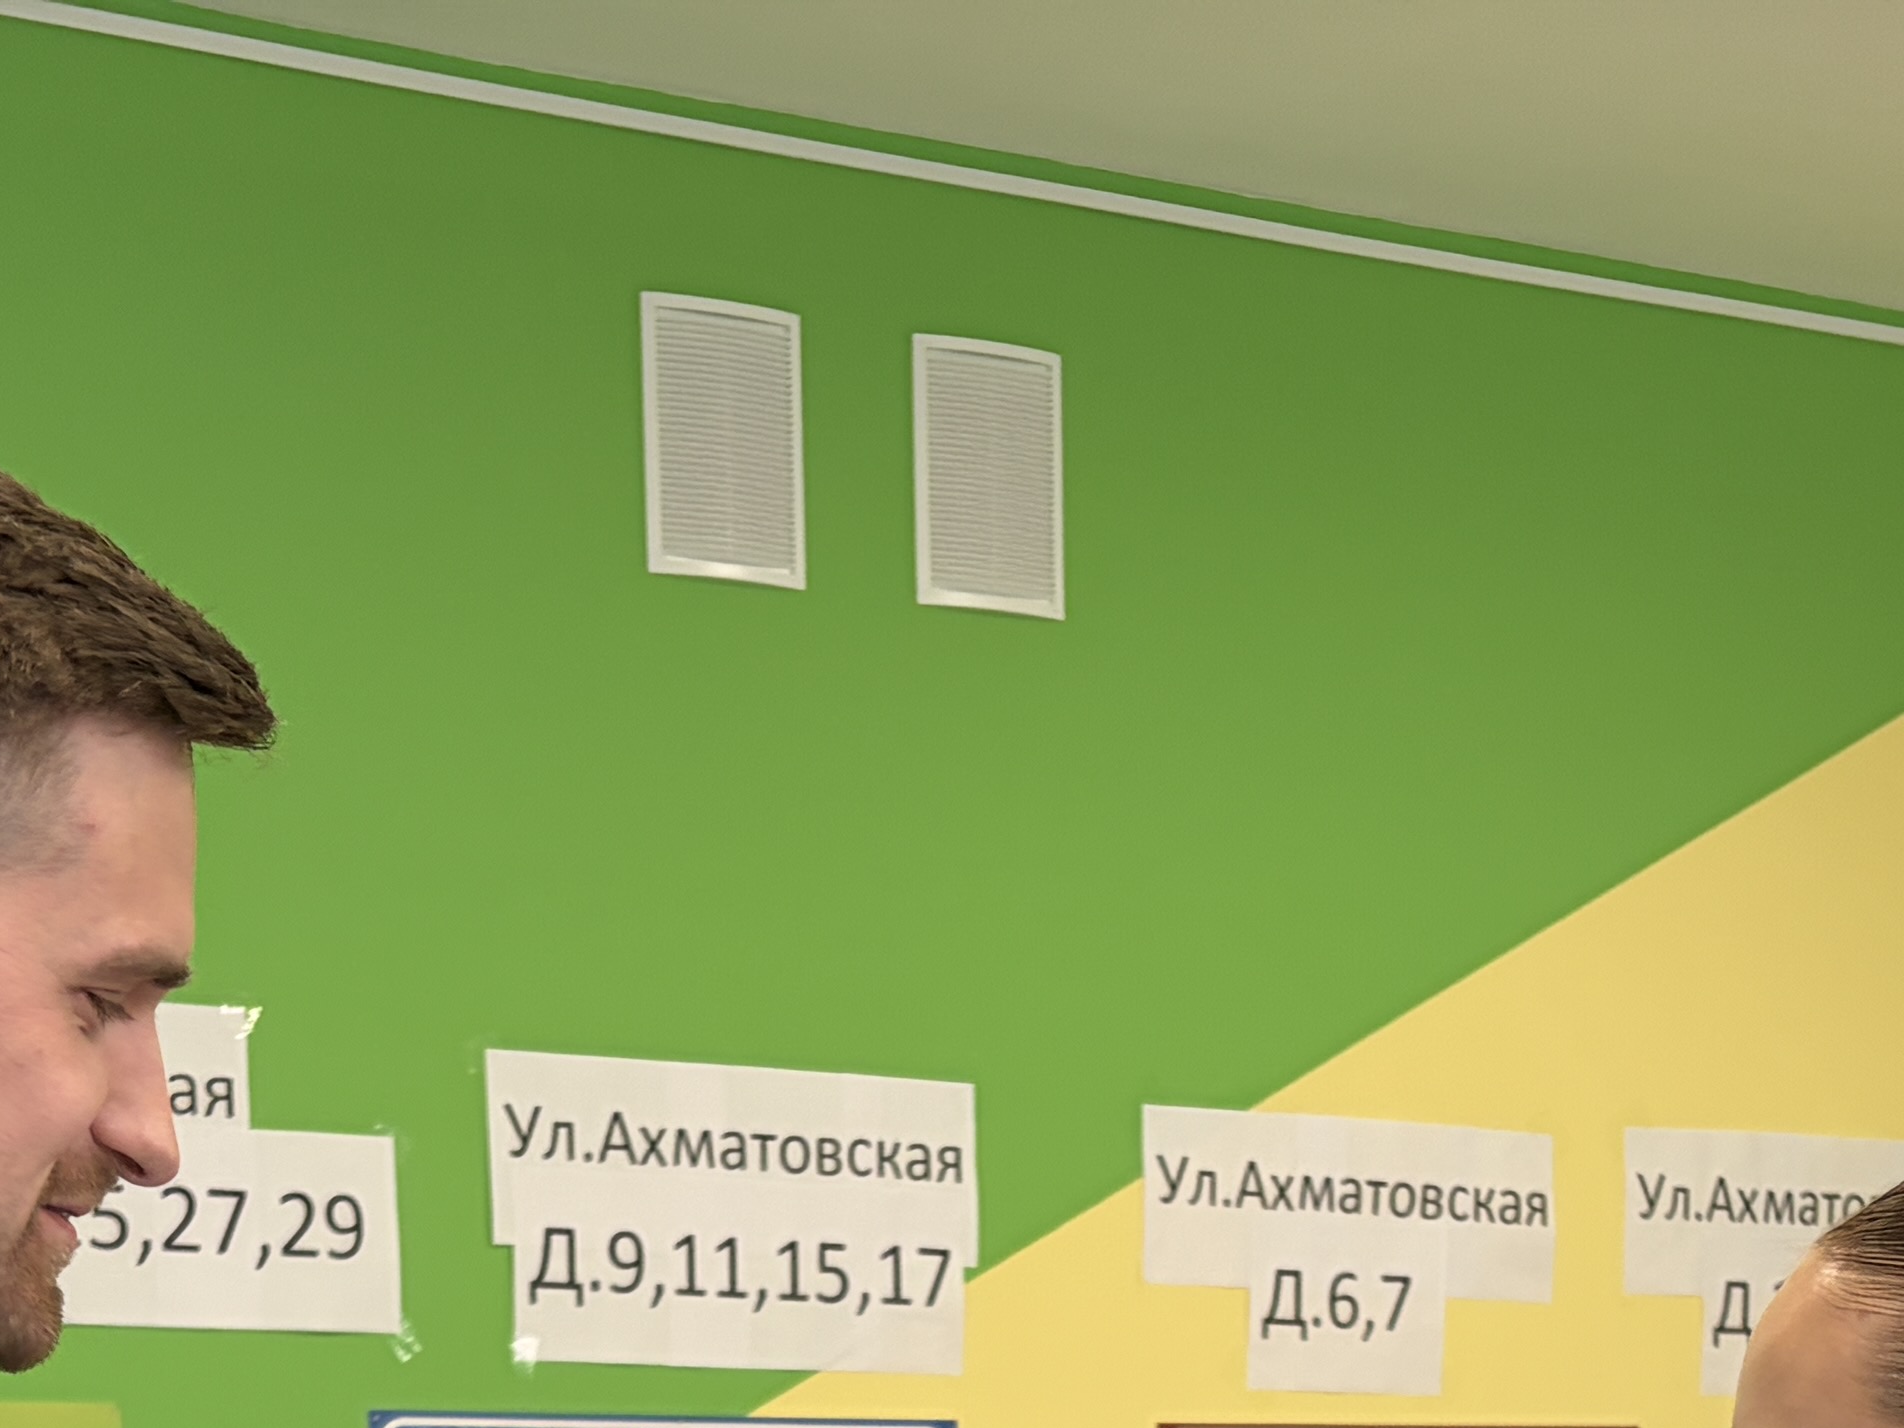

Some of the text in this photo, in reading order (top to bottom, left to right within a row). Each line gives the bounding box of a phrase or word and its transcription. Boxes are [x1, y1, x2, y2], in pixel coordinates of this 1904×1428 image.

[503, 1102, 964, 1185] Ул.Ахматовская
[90, 1185, 366, 1272] 5,27,29
[1155, 1154, 1549, 1229] Ул.Ахматовская
[1636, 1172, 1868, 1226] Ул.Ахмато
[529, 1226, 953, 1316] Д.9,11,15,17
[1260, 1268, 1413, 1342] Д.6,7
